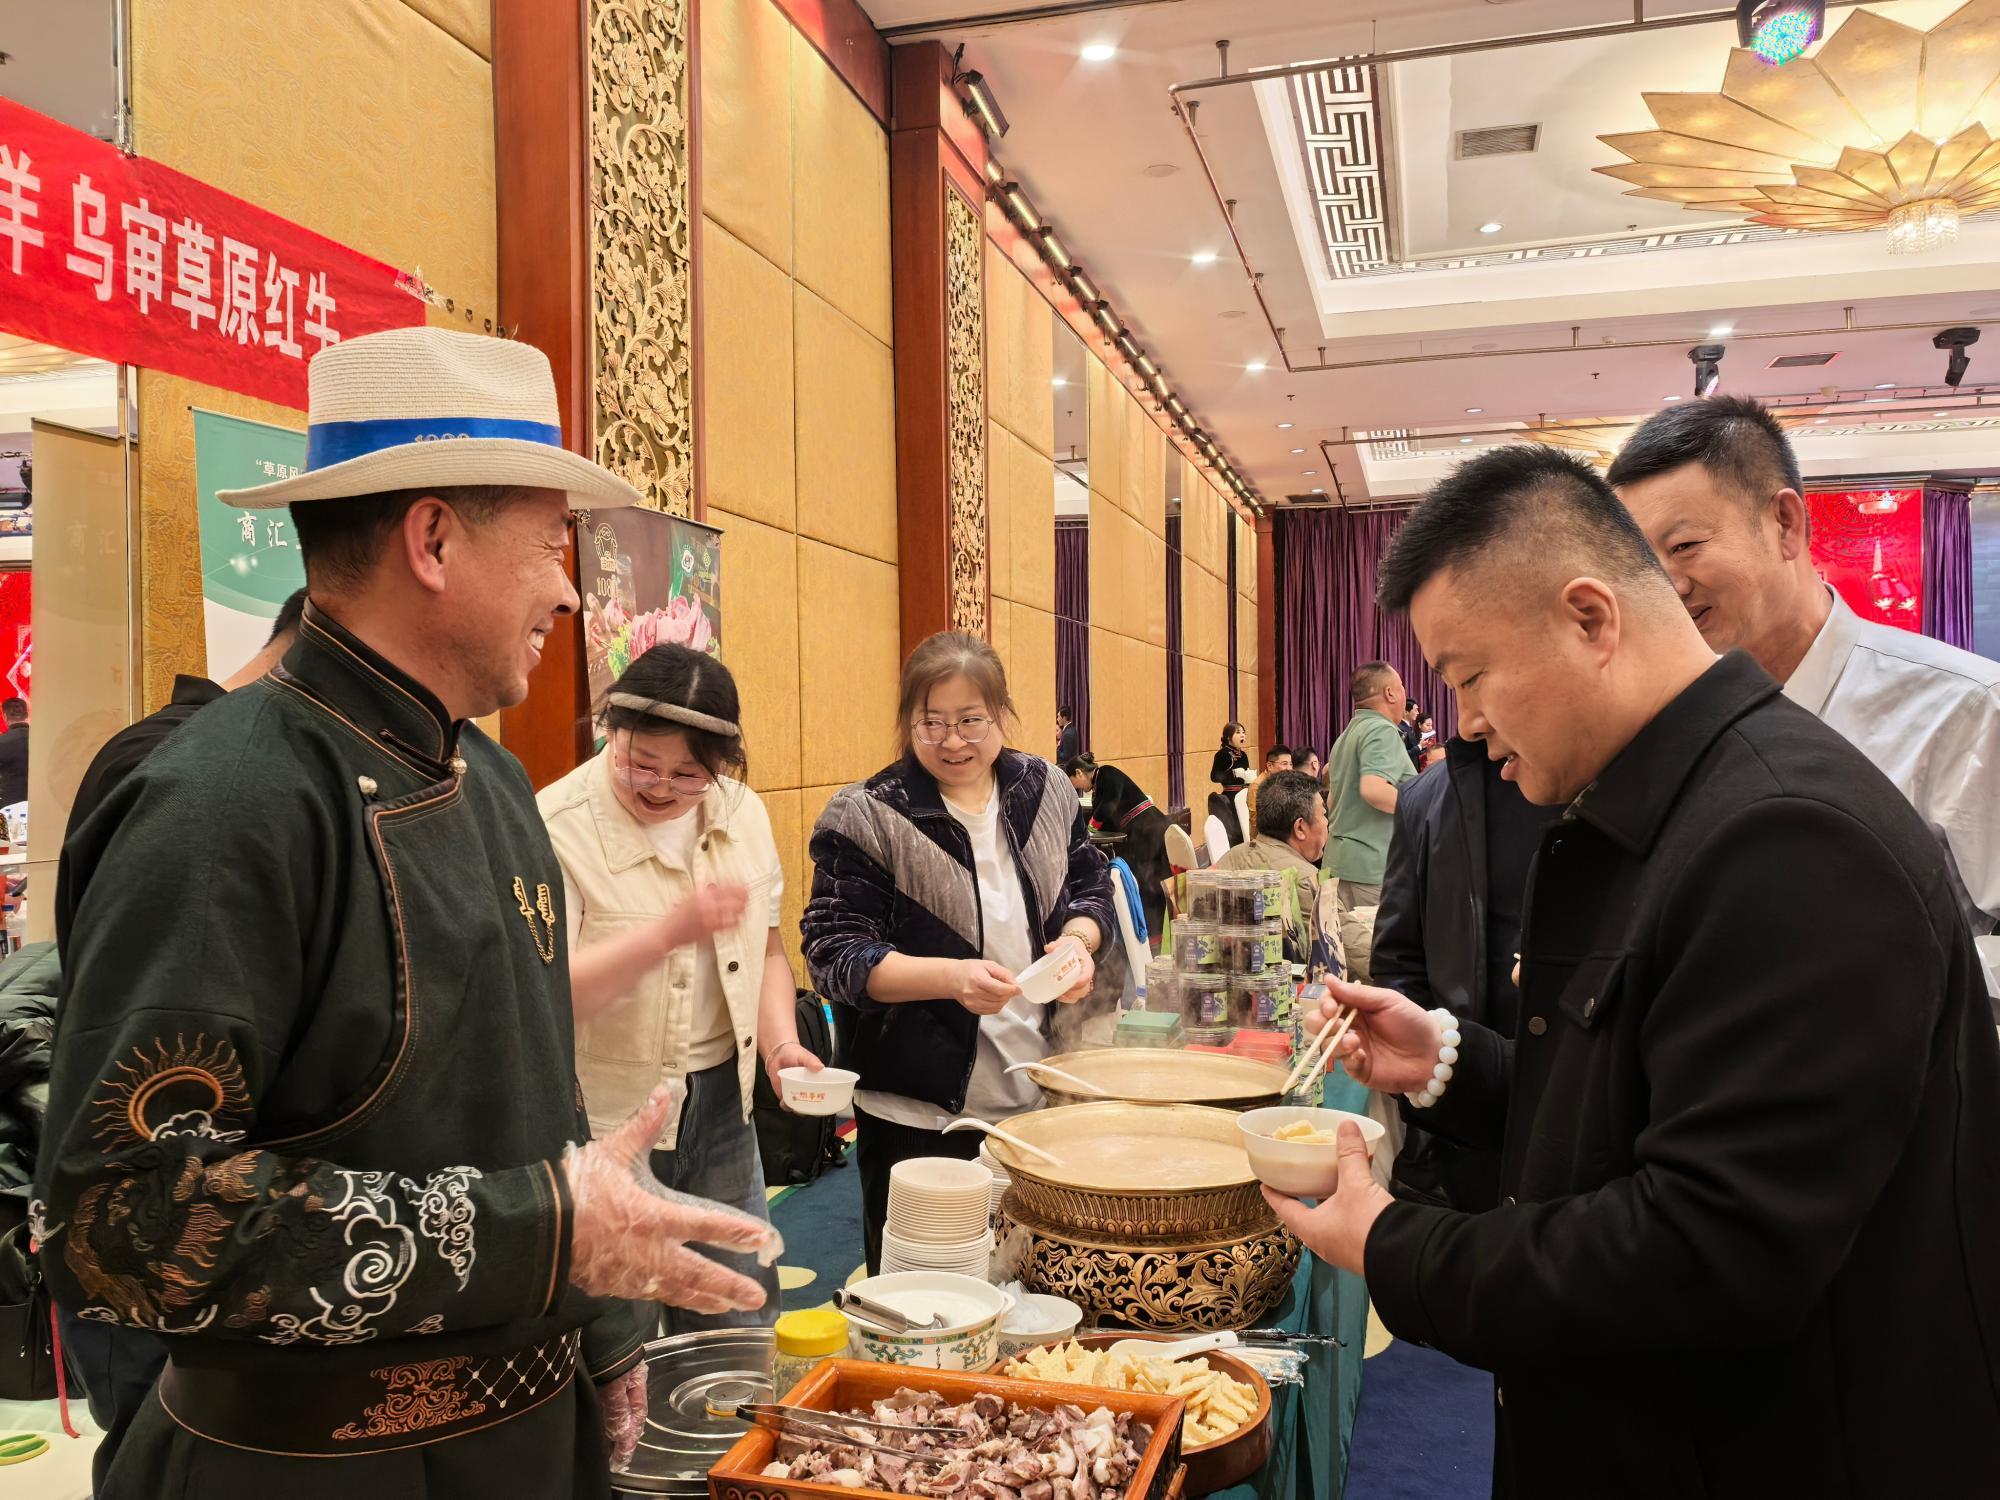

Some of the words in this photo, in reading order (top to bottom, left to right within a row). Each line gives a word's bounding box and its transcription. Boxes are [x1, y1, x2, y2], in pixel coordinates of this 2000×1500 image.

[66, 173, 341, 359] 乌审草原红牛
[256, 459, 305, 480] “草原风
[237, 511, 302, 550] 商汇
